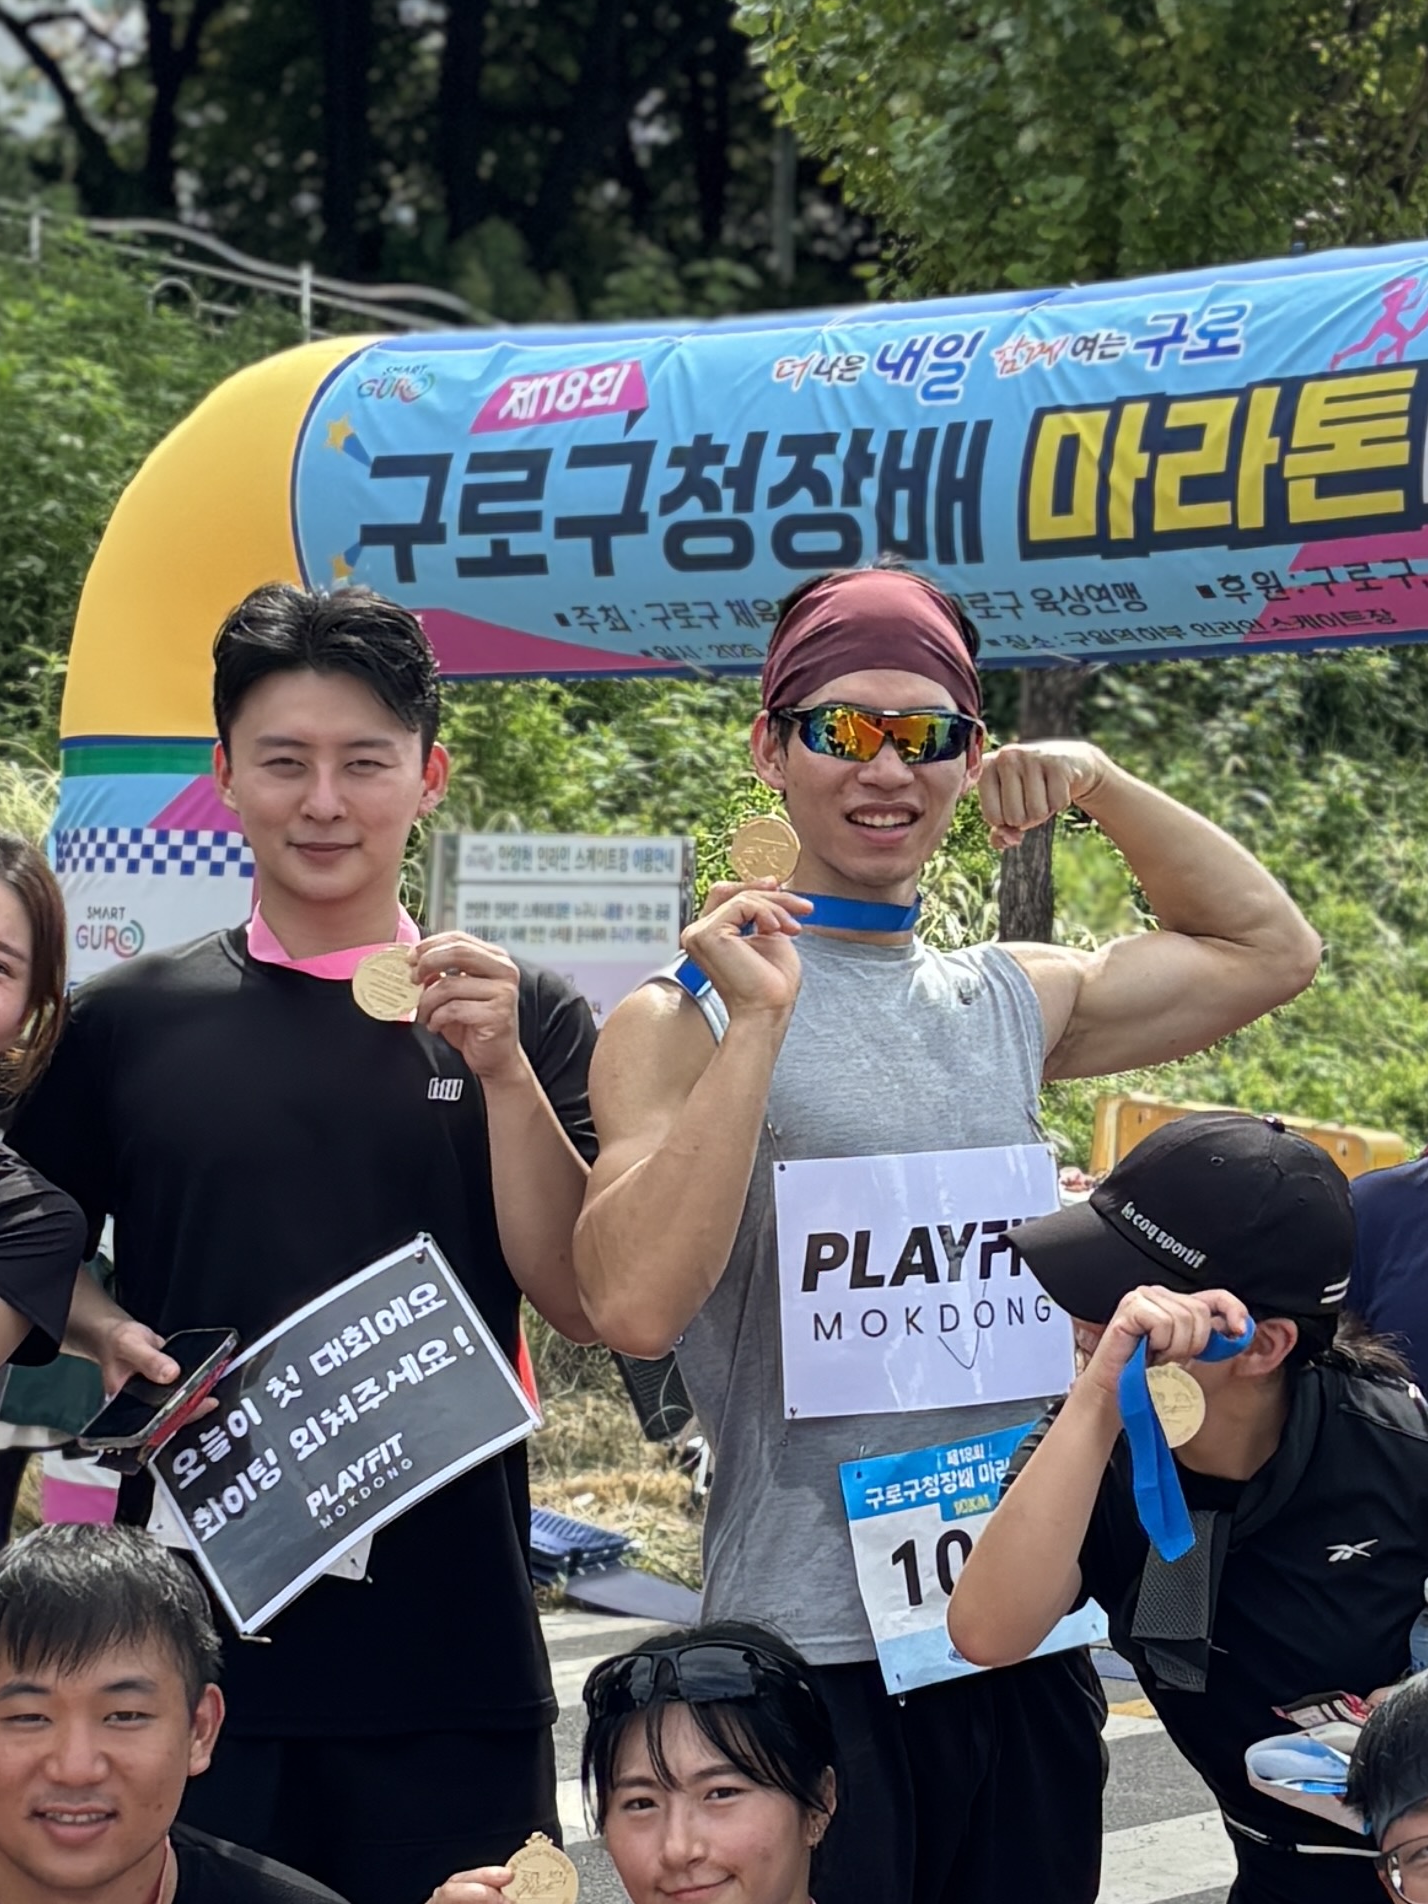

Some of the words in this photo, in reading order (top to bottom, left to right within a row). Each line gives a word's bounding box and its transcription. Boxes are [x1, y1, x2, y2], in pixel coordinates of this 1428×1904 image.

[498, 360, 631, 421] 제18회
[875, 329, 987, 405] 내일
[1073, 330, 1128, 362] 여는
[1133, 306, 1249, 368] 구로
[359, 419, 993, 584] 구로구청장배
[644, 600, 722, 631] 구로구
[1031, 581, 1150, 618] 육상연맹
[86, 905, 126, 921] SMART
[800, 1216, 1042, 1293] PLAYFI
[1155, 1230, 1209, 1270] sportif
[813, 1294, 1054, 1341] MOKDONG
[172, 1396, 263, 1491] 오늘이
[265, 1364, 304, 1409] 첫
[308, 1281, 448, 1378] 대회에요
[191, 1447, 283, 1544] 화이팅
[305, 1432, 404, 1518] PLAYFIT
[319, 1458, 414, 1530] MOKDONG
[865, 1465, 975, 1512] 구로구청장배
